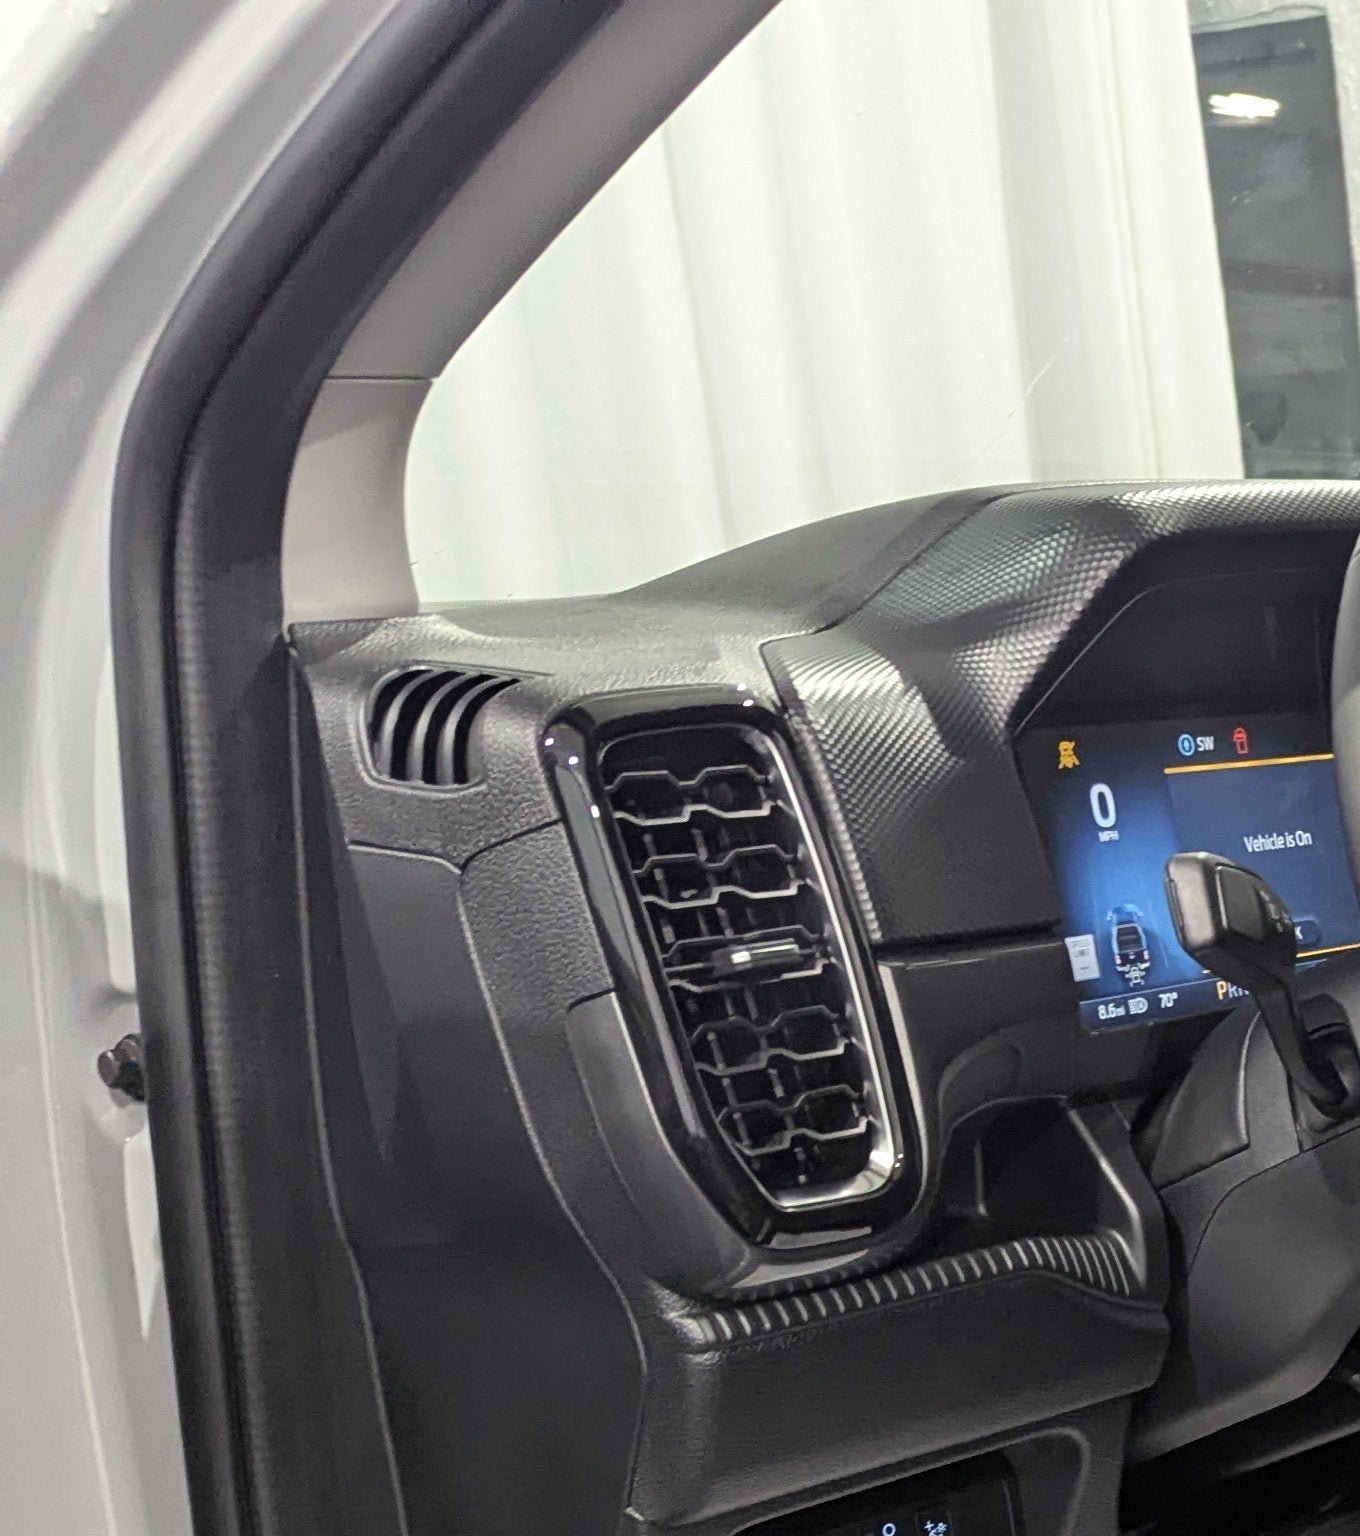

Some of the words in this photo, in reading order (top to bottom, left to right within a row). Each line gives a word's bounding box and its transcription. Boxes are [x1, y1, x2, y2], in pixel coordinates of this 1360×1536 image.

[1196, 735, 1215, 752] SW
[1089, 782, 1117, 828] 0
[1243, 832, 1285, 853] Vehicle
[1284, 831, 1296, 848] is
[1295, 830, 1313, 846] On
